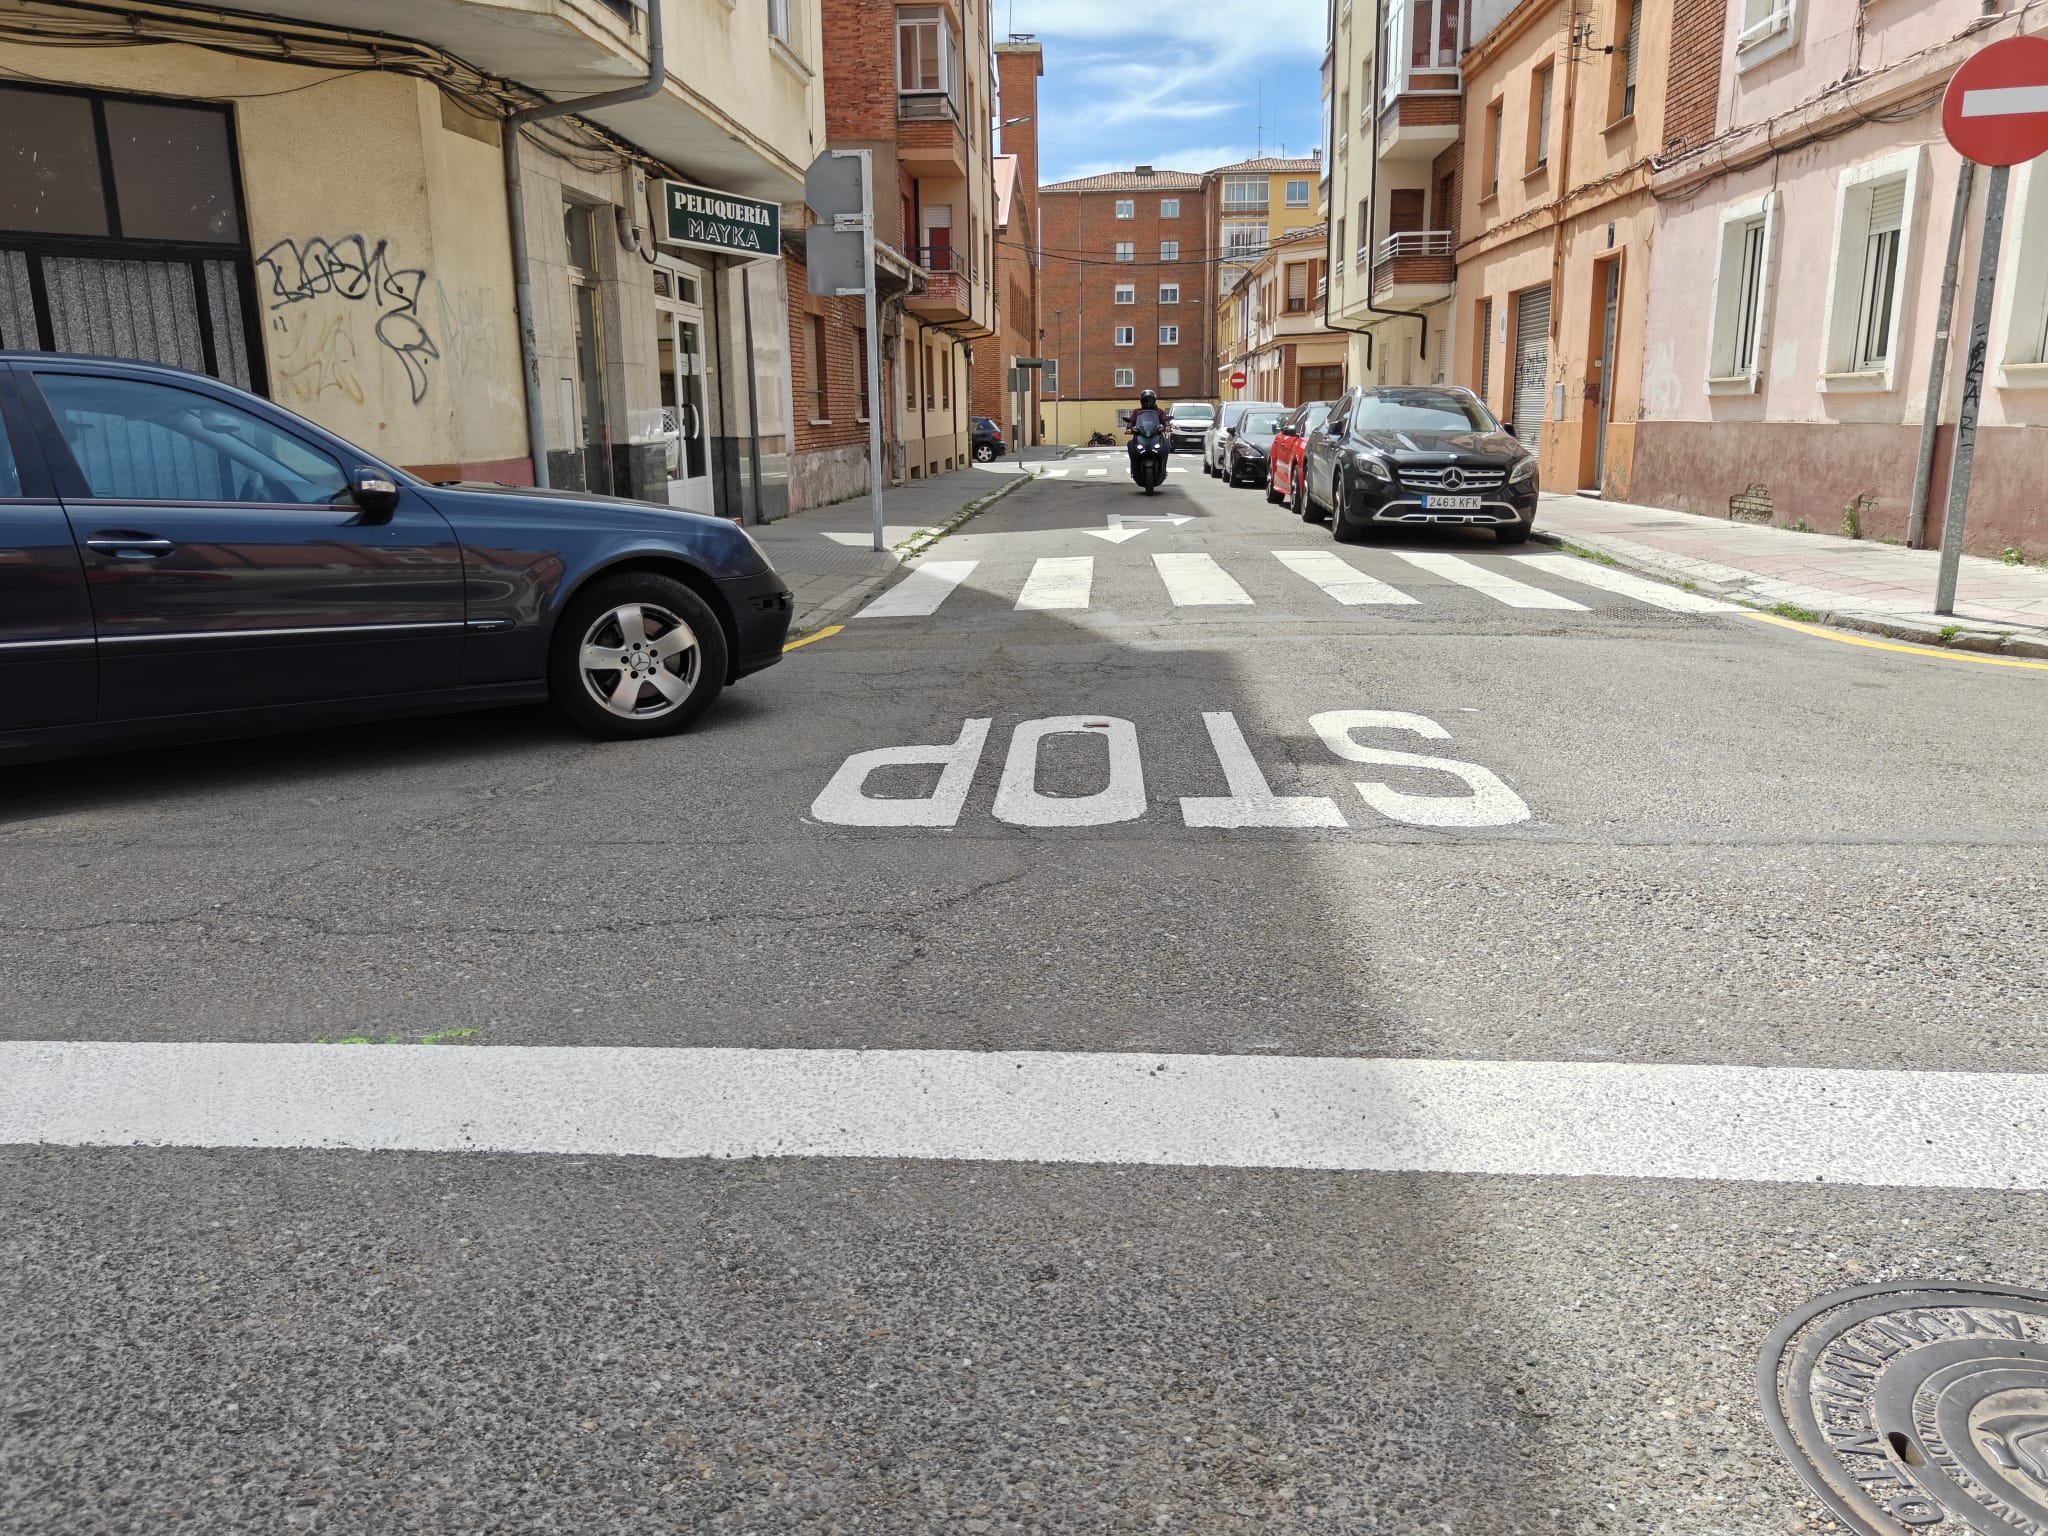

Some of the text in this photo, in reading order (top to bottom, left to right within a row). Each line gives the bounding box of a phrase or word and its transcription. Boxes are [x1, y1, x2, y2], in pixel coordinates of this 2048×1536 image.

[674, 191, 770, 226] PELUQUERÍA
[687, 217, 760, 249] MAYKA
[1429, 497, 1479, 509] 2463 KFK
[811, 709, 1530, 828] STOP
[1818, 1309, 2026, 1525] AYUNTAMIENTO
